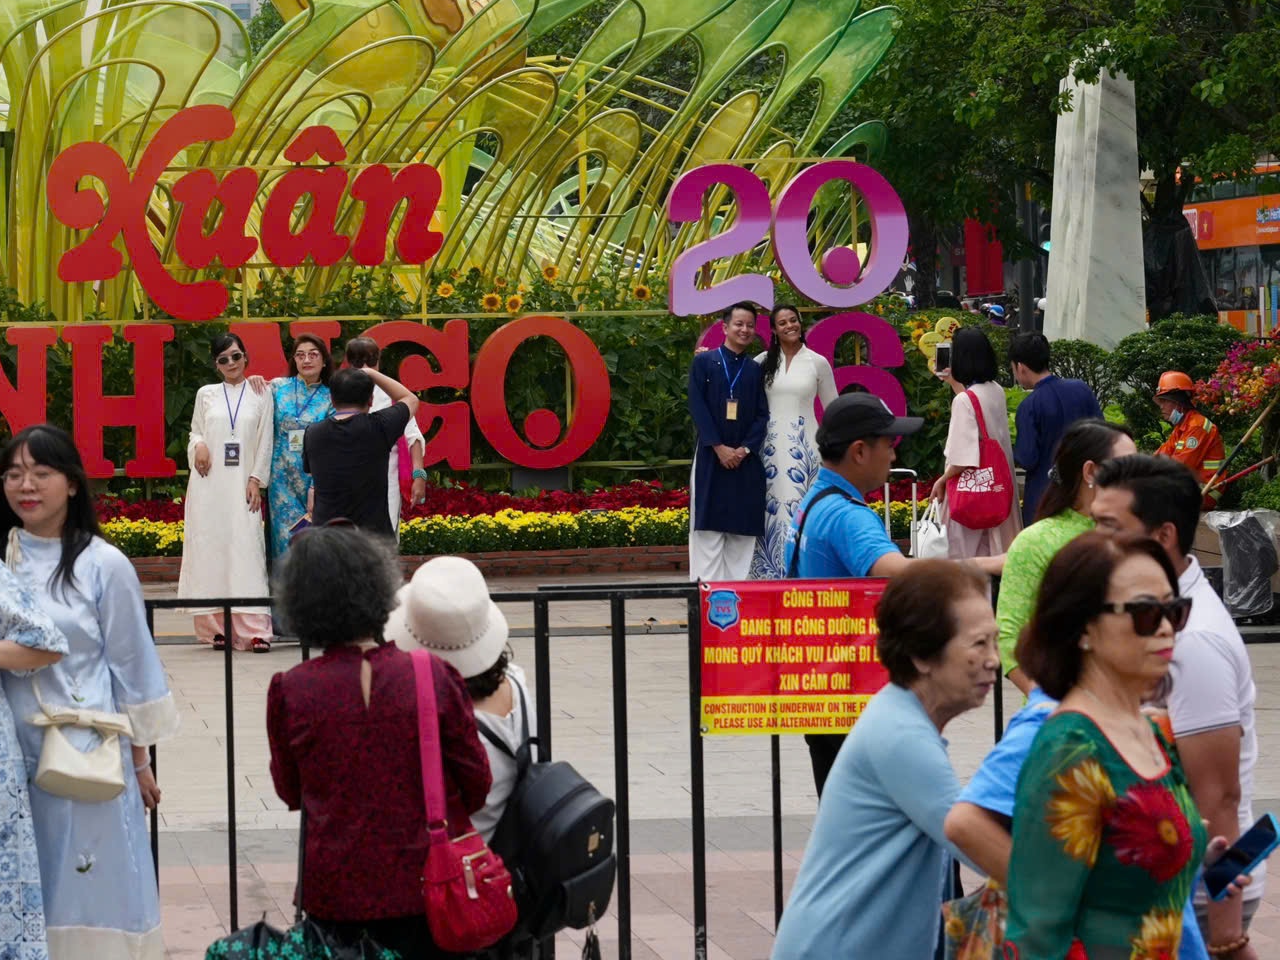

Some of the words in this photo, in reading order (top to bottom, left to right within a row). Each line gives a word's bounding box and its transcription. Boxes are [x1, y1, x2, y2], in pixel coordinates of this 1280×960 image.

[46, 104, 444, 322] Xuân
[666, 159, 910, 318] 20
[783, 587, 813, 607] CÔNG
[817, 587, 849, 607] TRÌNH
[740, 618, 771, 636] ĐANG
[774, 618, 791, 635] THI
[794, 615, 825, 635] CÔNG
[828, 614, 866, 635] ĐƯỜNG
[868, 617, 881, 634] H
[704, 646, 738, 664] MONG
[741, 643, 763, 664] QUÝ
[766, 643, 803, 663] KHÁCH
[806, 645, 824, 662] VUI
[827, 644, 856, 662] LÒNG
[859, 645, 871, 662] ĐI
[780, 673, 799, 690] XIN
[802, 668, 827, 690] CẢM
[831, 673, 851, 689] ƠN!
[704, 703, 766, 715] CONSTRUCTION
[769, 703, 777, 713] IS
[780, 702, 824, 713] UNDERWAY
[828, 702, 840, 712] ON
[842, 702, 857, 712] THE
[713, 718, 745, 729] PLEASE
[747, 718, 763, 728] USE
[766, 718, 778, 728] AN
[780, 717, 832, 728] ALTERNATIVE
